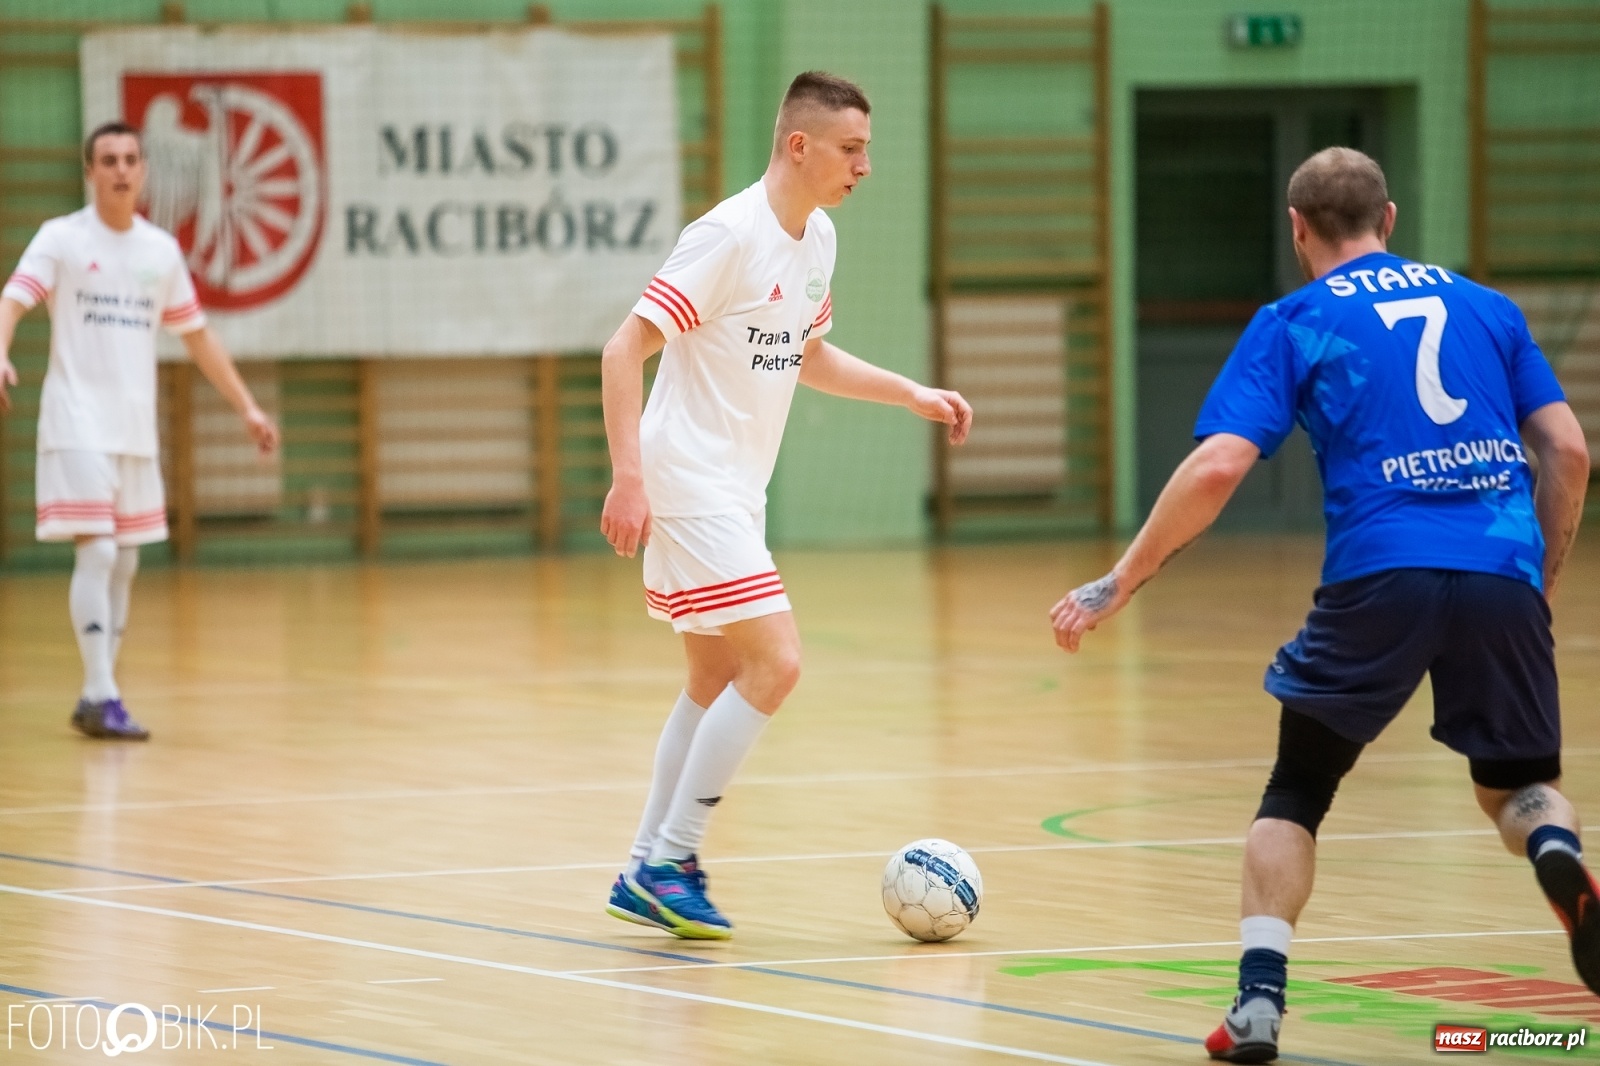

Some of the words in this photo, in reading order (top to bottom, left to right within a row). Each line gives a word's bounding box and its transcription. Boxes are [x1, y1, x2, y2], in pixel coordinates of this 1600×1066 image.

[377, 121, 619, 177] MIASTO
[345, 187, 661, 255] RACIBÓRZ
[1325, 264, 1453, 297] START
[1373, 295, 1468, 425] 7
